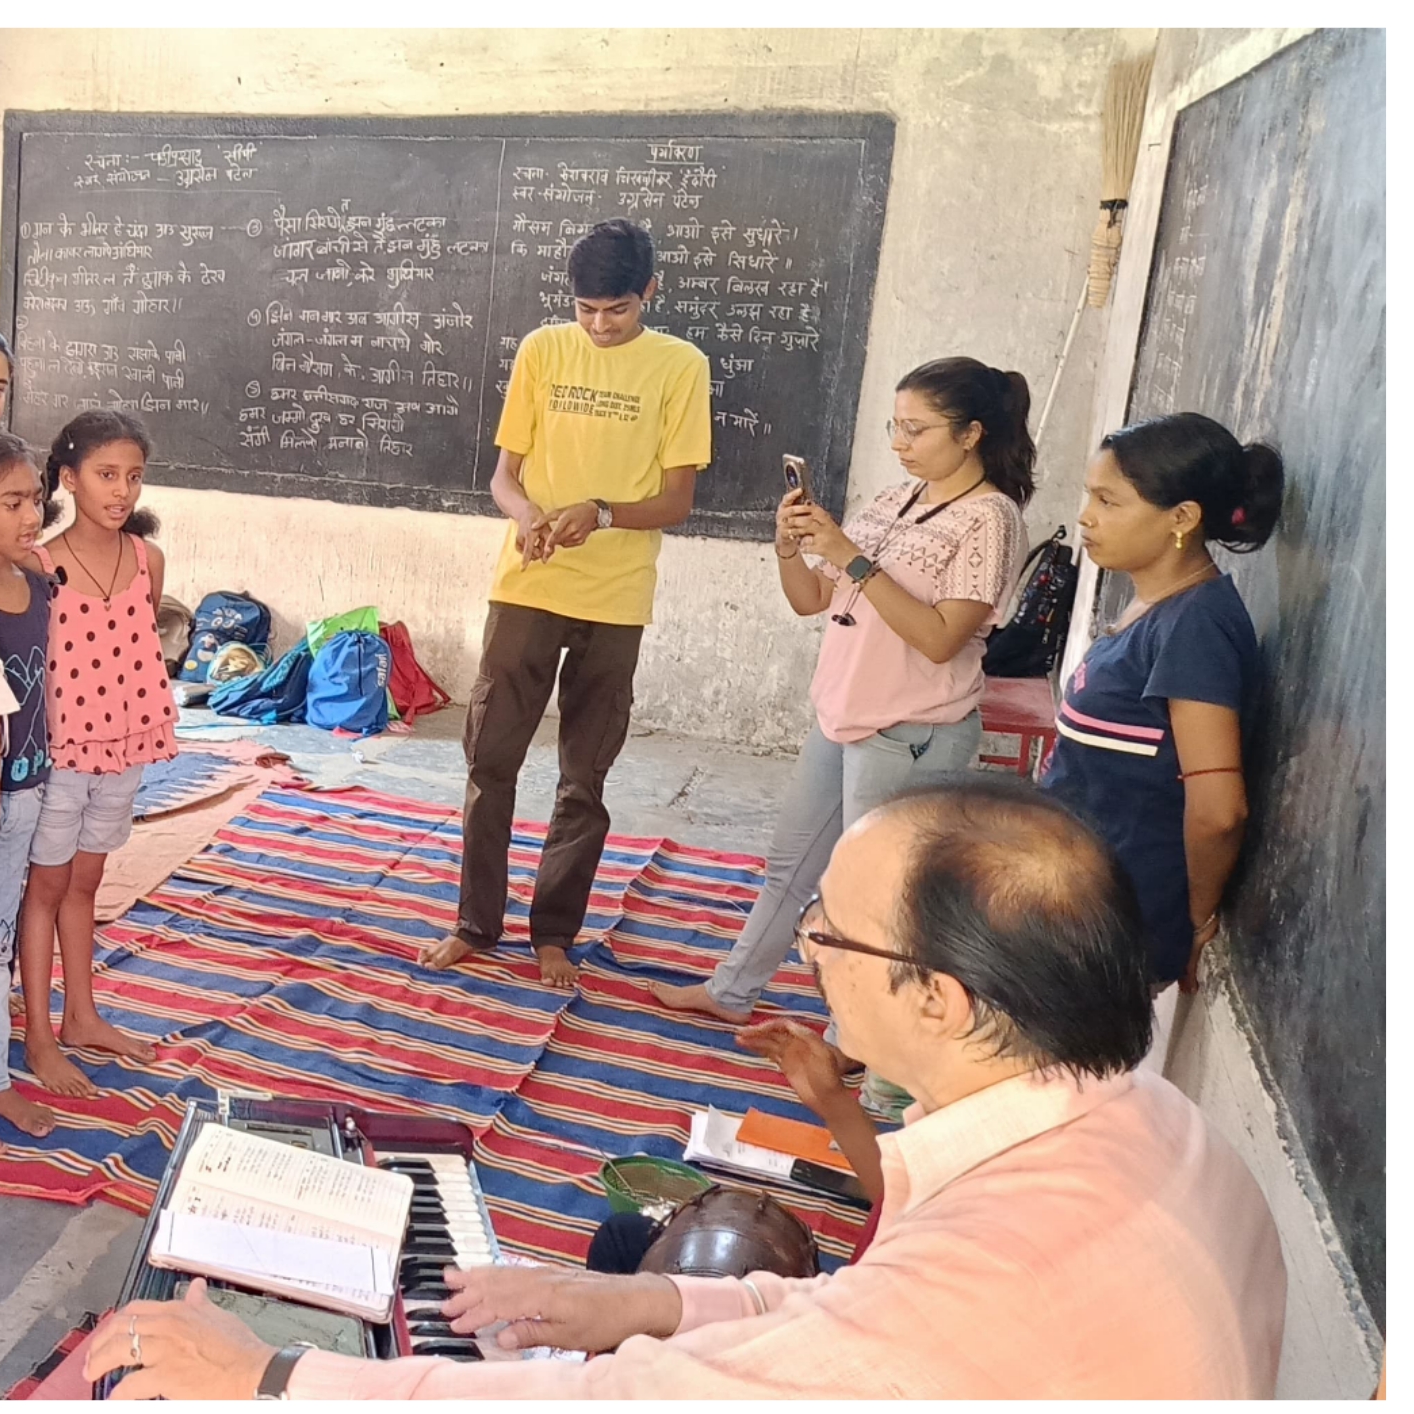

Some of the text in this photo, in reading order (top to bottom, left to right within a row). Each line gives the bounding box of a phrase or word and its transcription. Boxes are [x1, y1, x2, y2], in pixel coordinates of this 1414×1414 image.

[226, 163, 259, 182] पटेल
[56, 212, 77, 238] के
[274, 205, 302, 236] पैसा
[512, 212, 553, 237] मौसम
[666, 216, 704, 240] आओ
[711, 219, 736, 245] इसे
[511, 240, 529, 257] कि
[657, 243, 691, 265] आओ
[693, 246, 717, 271] इसे
[177, 260, 192, 285] के
[678, 276, 721, 296] अम्बर
[727, 275, 771, 298] बिलख
[778, 280, 808, 298] रहा
[539, 289, 575, 312] भूमंड
[674, 296, 722, 321] समुंदर
[726, 303, 764, 322] उलझ
[769, 306, 794, 321] रहा
[685, 326, 710, 342] हम
[716, 322, 745, 344] कैसे
[749, 326, 776, 346] दिन
[568, 386, 598, 402] ROCK
